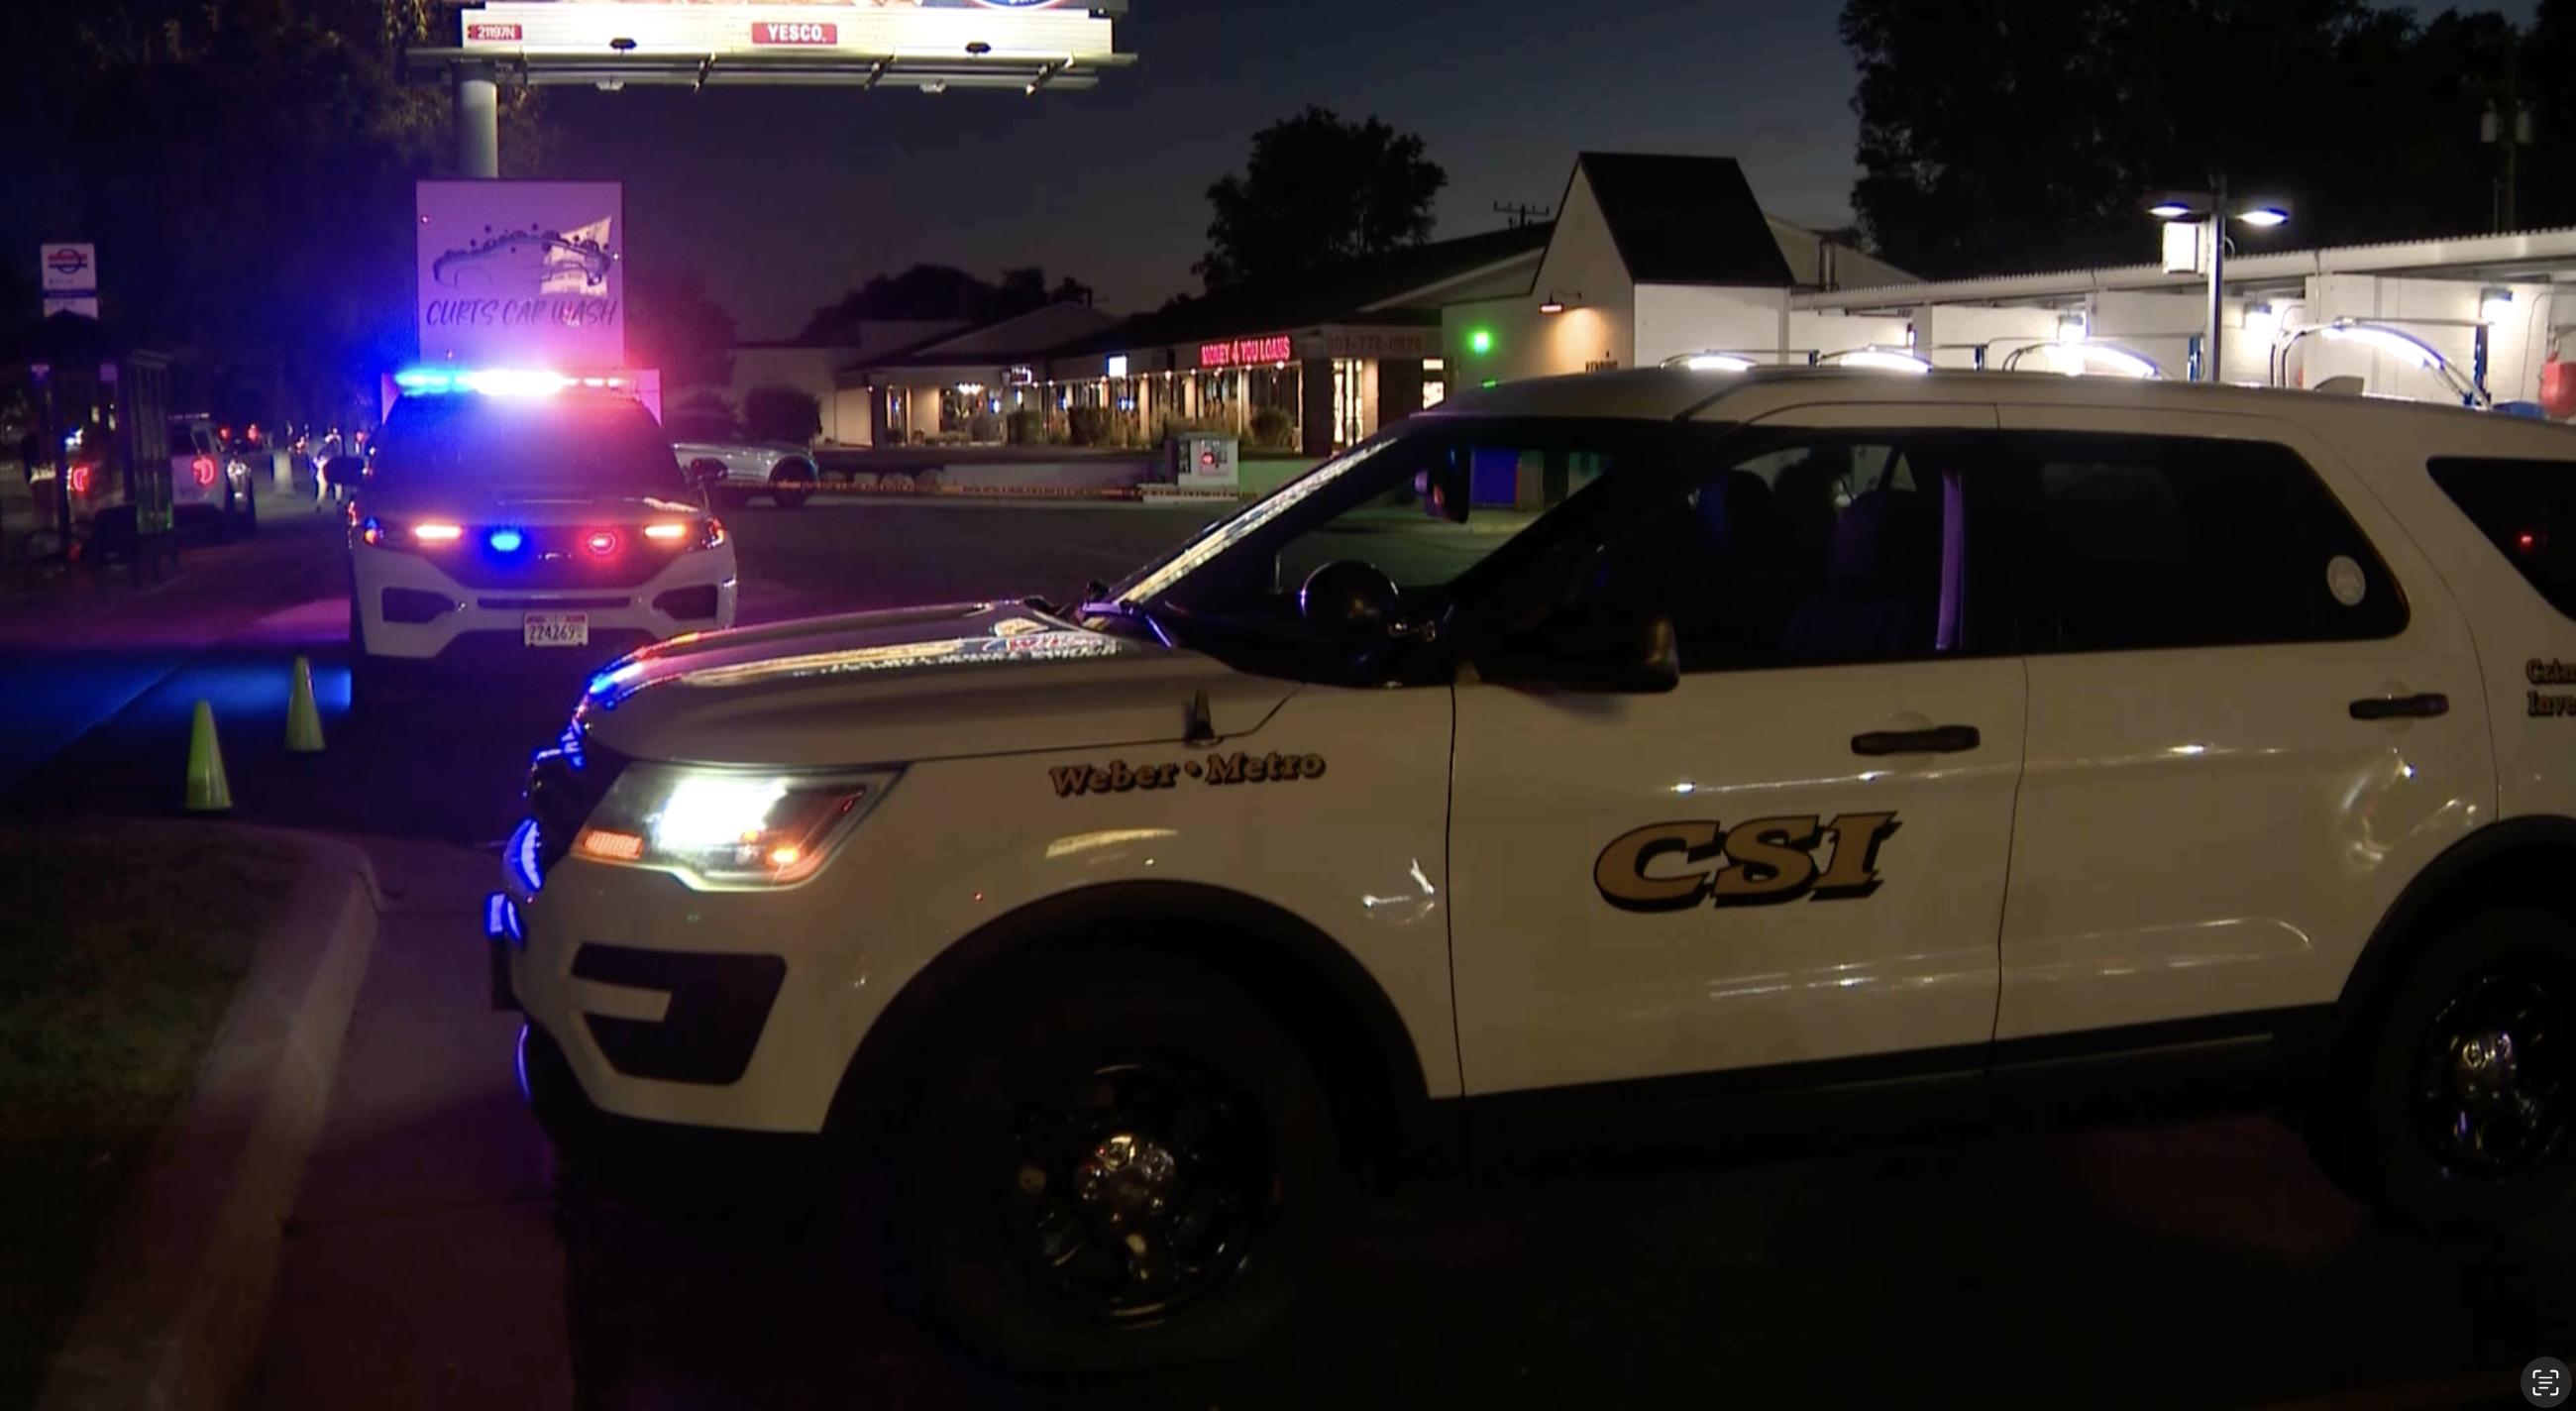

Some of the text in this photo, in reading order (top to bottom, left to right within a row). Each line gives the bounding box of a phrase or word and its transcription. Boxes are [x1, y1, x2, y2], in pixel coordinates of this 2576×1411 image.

[503, 299, 548, 326] CAR
[551, 298, 619, 327] WASH
[1201, 335, 1290, 366] MONEY 4 YOU LOANS
[1048, 751, 1327, 798] Weber Metro
[1593, 811, 1902, 913] CSI
